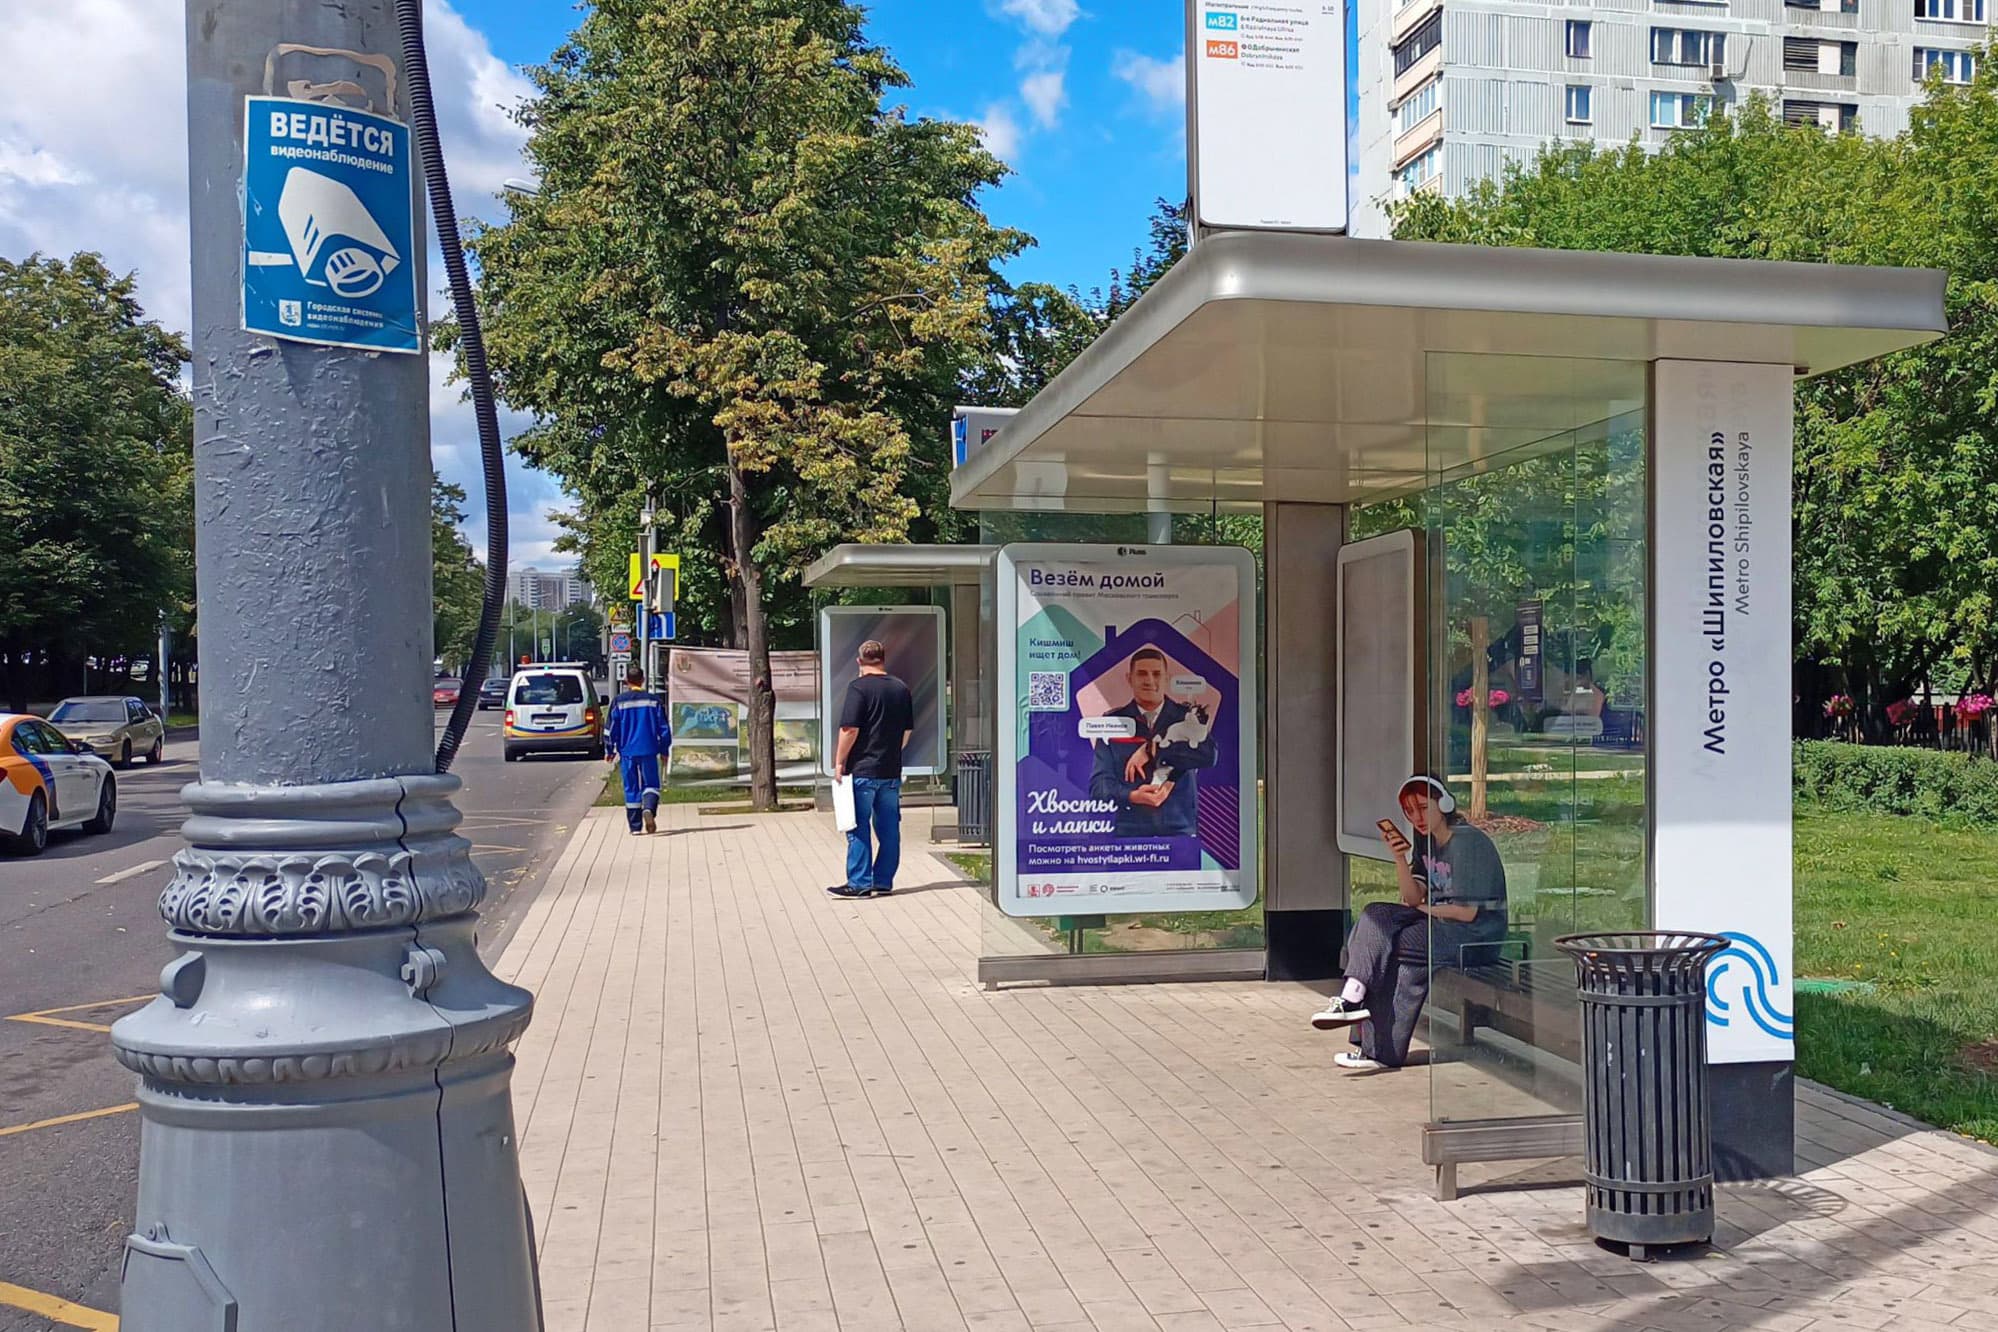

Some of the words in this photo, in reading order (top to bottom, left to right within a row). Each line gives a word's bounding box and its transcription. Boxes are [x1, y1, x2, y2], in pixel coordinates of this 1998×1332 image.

[1208, 16, 1235, 28] м82
[1209, 44, 1236, 56] м86
[270, 111, 394, 156] ВЕДЁТСЯ
[270, 145, 394, 174] видеонаблюдение
[307, 301, 352, 314] Городская
[307, 313, 384, 328] видеонаблюдения
[1734, 431, 1753, 554] Shipilovskaya
[1703, 431, 1725, 652] «Шипиловская»
[1030, 568, 1094, 587] Везём
[1100, 572, 1164, 590] домой
[1736, 560, 1750, 615] Metro
[1029, 638, 1074, 647] Кишмиш
[1029, 652, 1055, 660] ищет
[1057, 650, 1081, 660] дом!
[1704, 660, 1730, 754] Метро
[1027, 788, 1118, 814] Хвосты
[1032, 822, 1047, 834] и
[1049, 820, 1115, 834] лапки
[1028, 844, 1087, 854] Посмотреть
[1123, 844, 1170, 852] животных
[1028, 857, 1062, 865] можно
[1063, 857, 1076, 865] на
